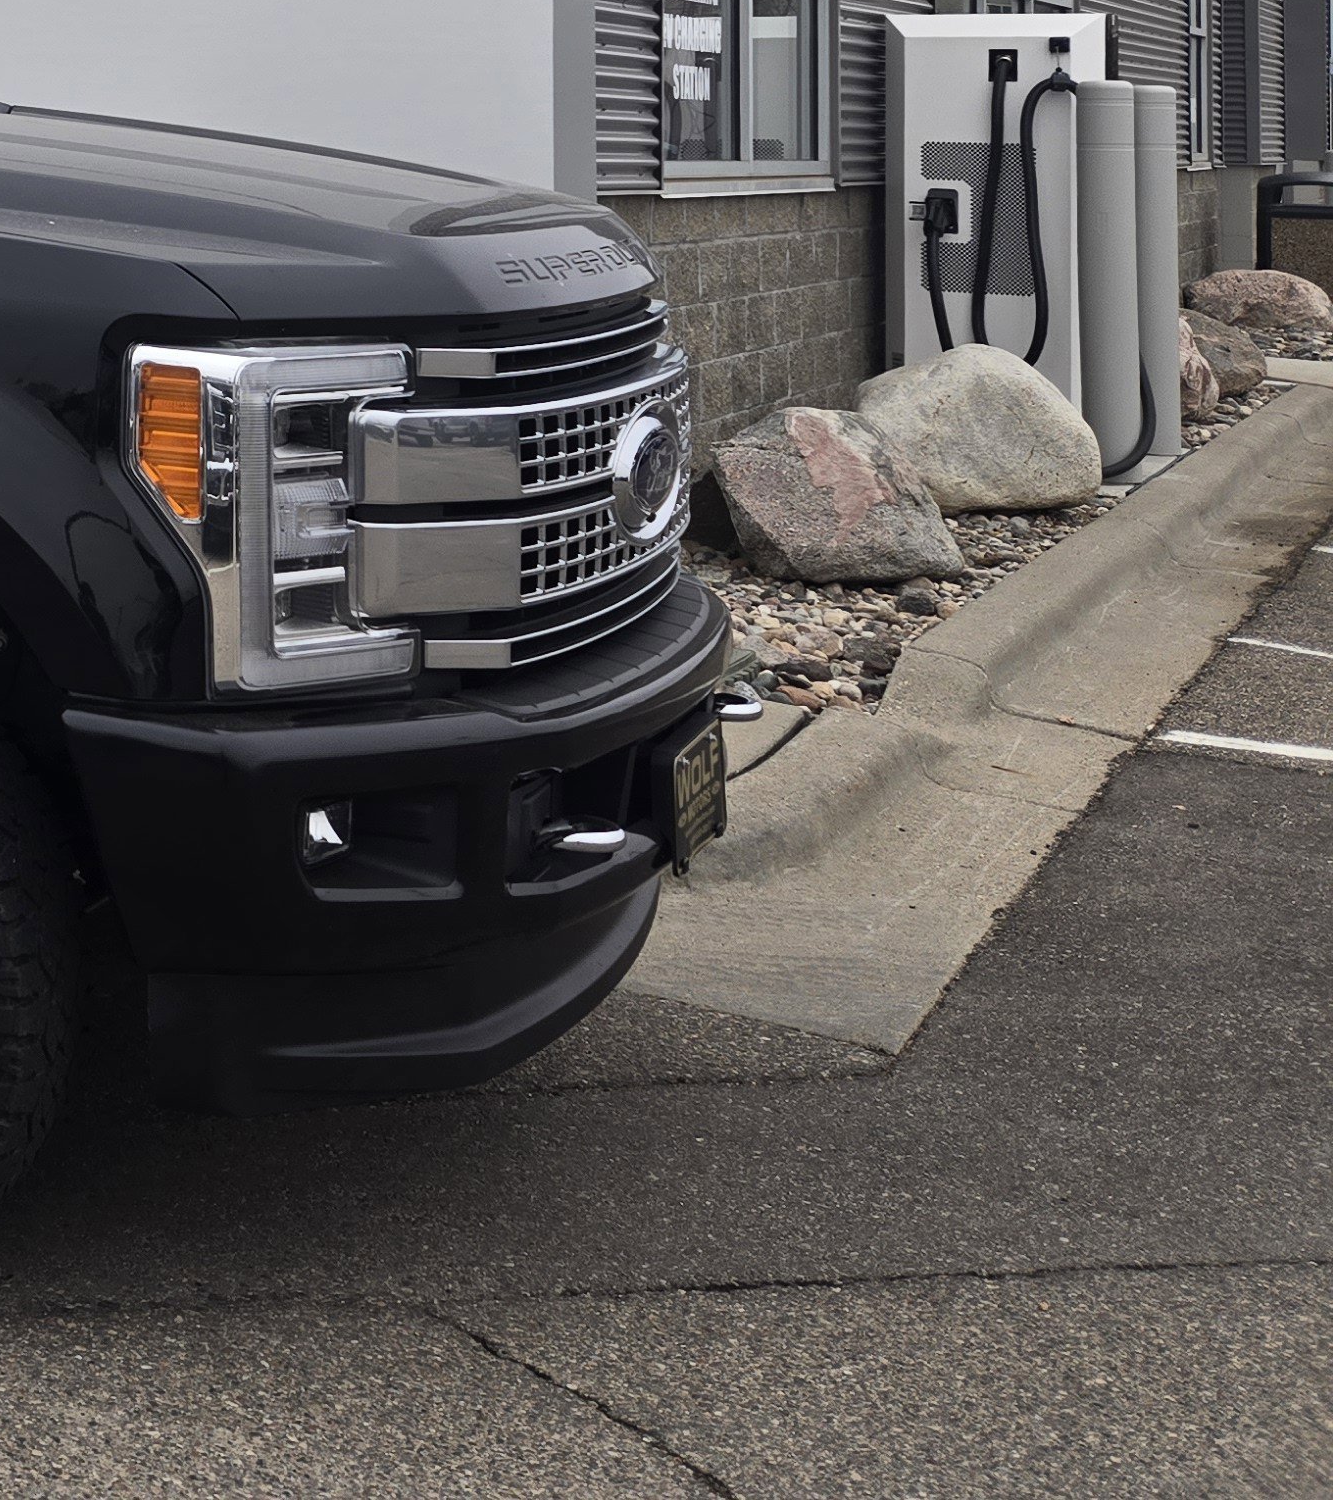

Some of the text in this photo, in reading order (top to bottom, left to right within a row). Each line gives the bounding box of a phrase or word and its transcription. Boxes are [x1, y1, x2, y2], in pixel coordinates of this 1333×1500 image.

[674, 15, 722, 53] CHARGING
[673, 63, 710, 101] STATION
[496, 250, 613, 288] SUPER
[677, 740, 719, 809] WOLF
